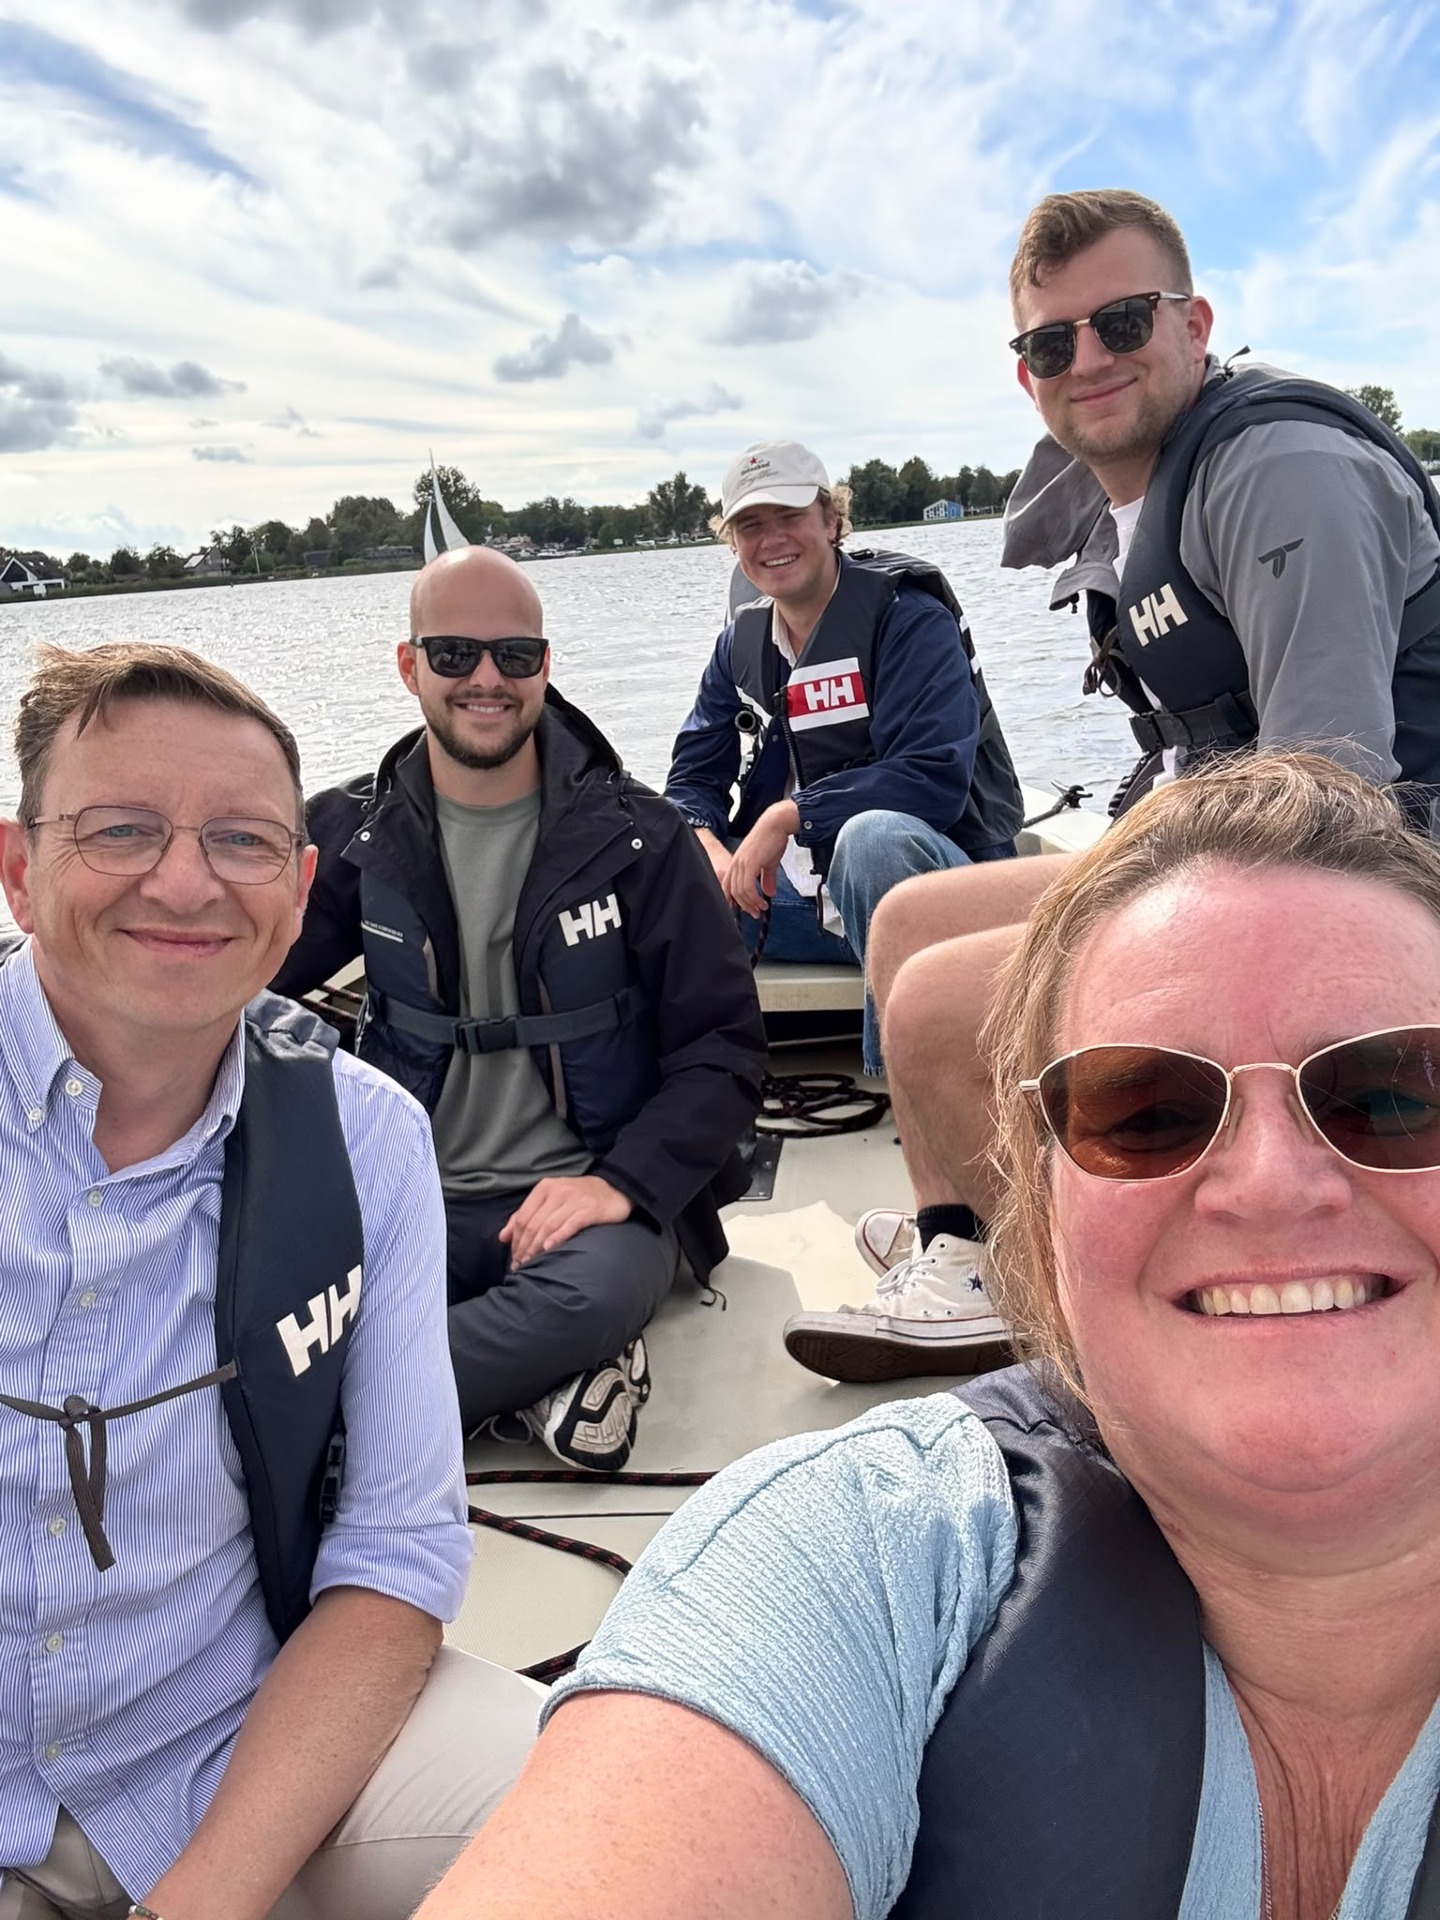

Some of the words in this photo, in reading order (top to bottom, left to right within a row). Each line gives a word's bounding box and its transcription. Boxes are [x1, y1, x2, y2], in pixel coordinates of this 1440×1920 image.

[1128, 583, 1189, 647] HH
[803, 676, 855, 711] HH
[558, 893, 622, 947] HH
[276, 1263, 362, 1377] HH
